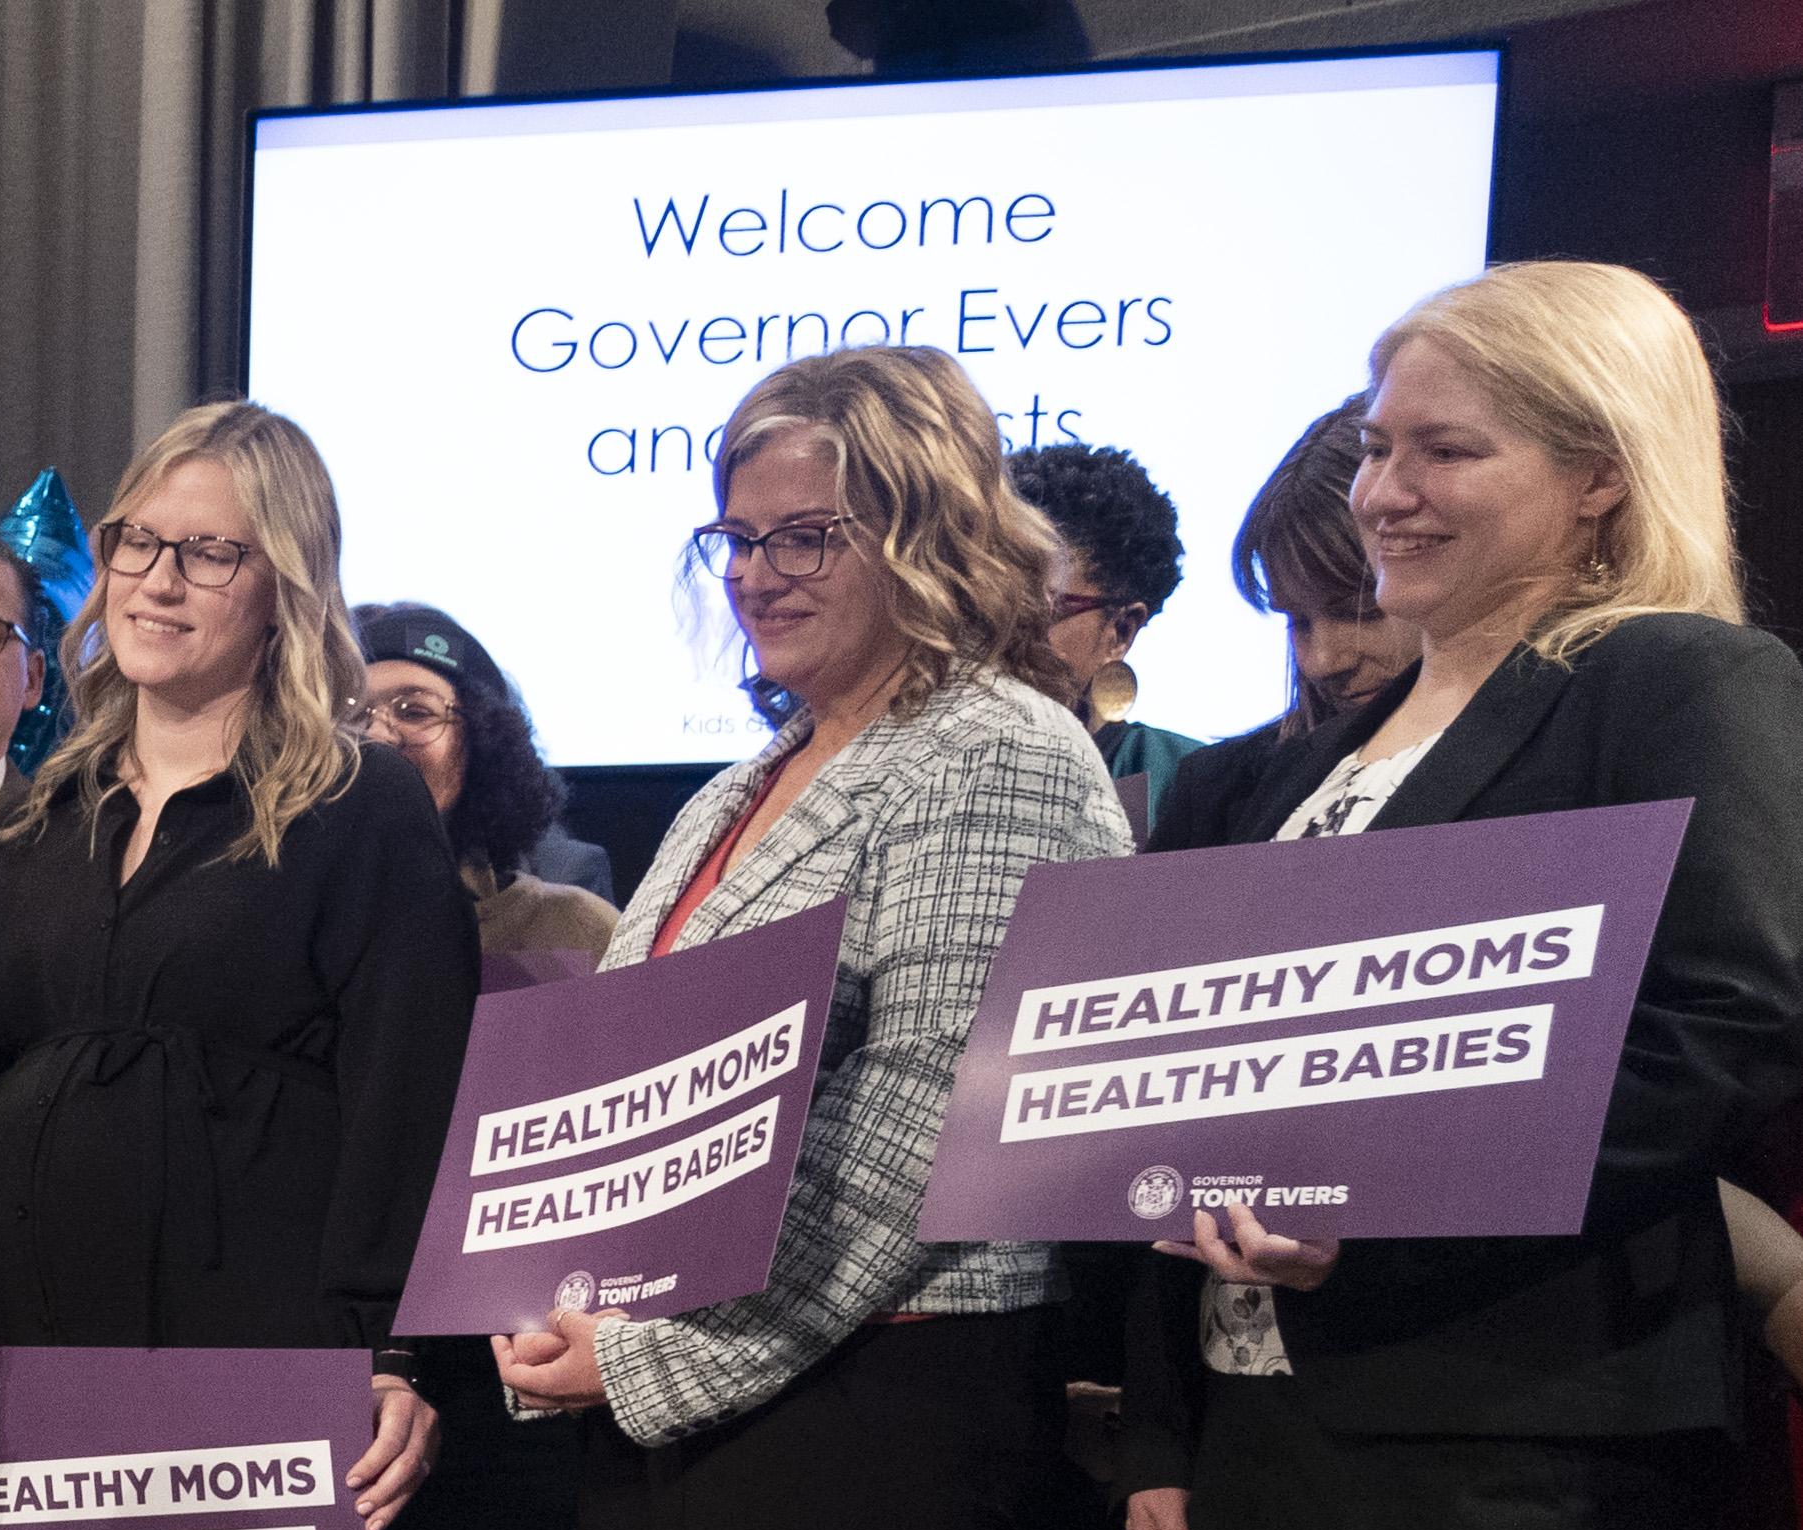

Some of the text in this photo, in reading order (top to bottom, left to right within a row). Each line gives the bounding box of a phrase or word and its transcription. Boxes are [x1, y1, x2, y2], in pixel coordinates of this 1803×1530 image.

[633, 188, 1056, 259] Welcome
[511, 288, 1173, 372] Governor Evers
[588, 425, 723, 475] an
[1034, 927, 1572, 1039] HEALTHY MOMS
[490, 1024, 791, 1161] HEALTHY MOMS
[1018, 1024, 1531, 1122] HEALTHY BABIES
[478, 1116, 768, 1235] HEALTHY BABIES
[1190, 1185, 1348, 1207] TONY EVERS
[1192, 1175, 1263, 1186] GOVERNOR
[598, 1284, 641, 1306] TONY
[640, 1274, 678, 1299] EVERS
[170, 1458, 315, 1502] MOMS
